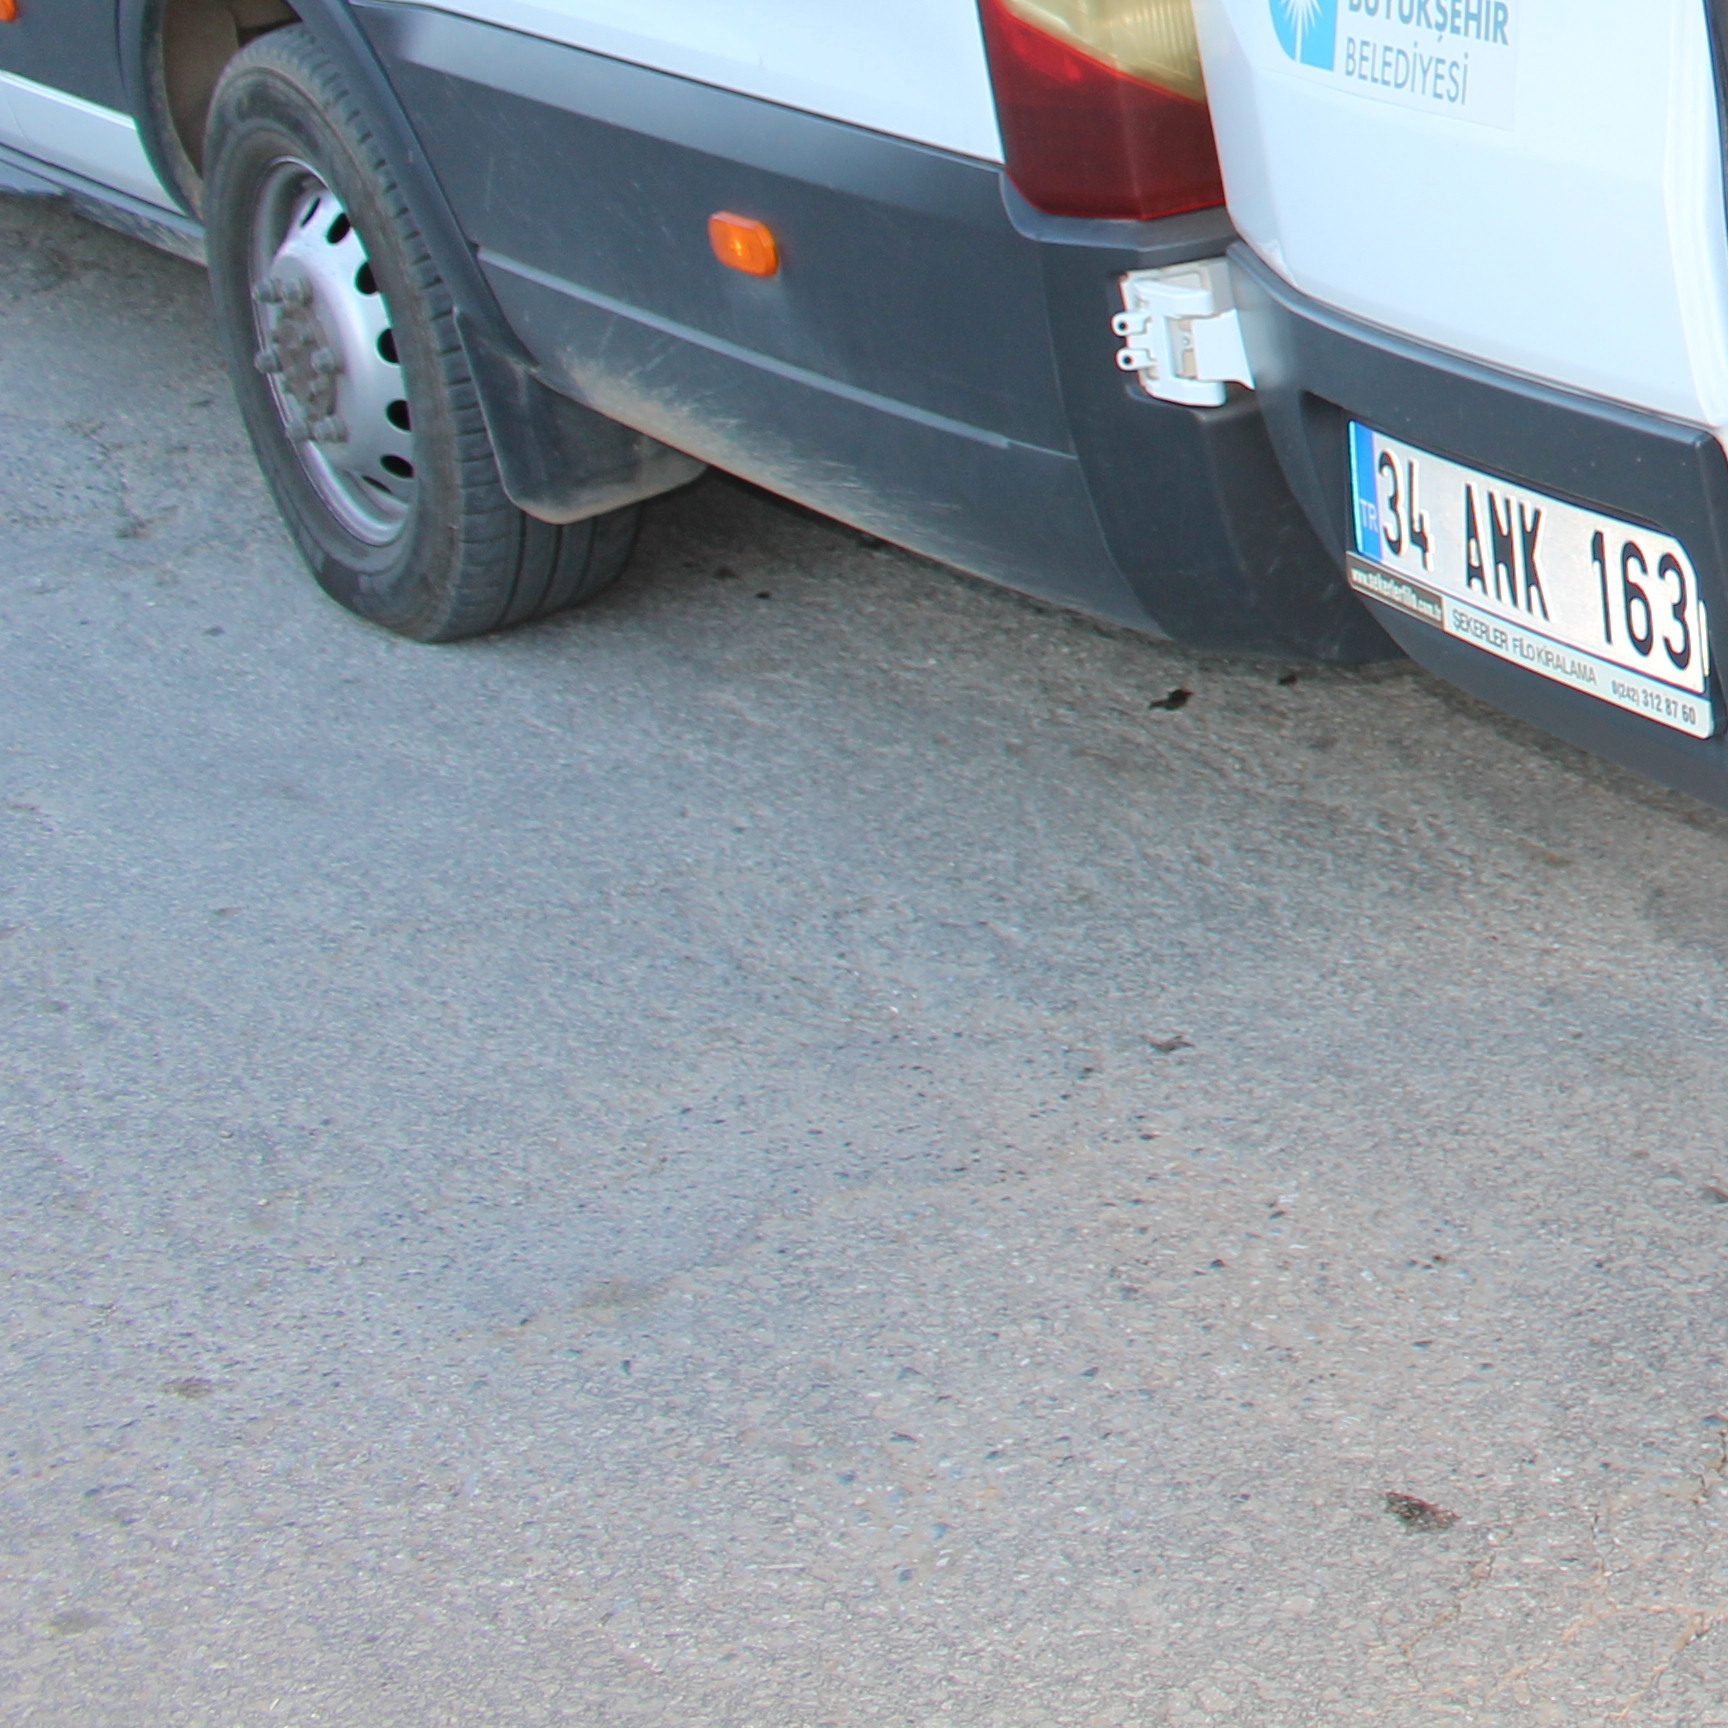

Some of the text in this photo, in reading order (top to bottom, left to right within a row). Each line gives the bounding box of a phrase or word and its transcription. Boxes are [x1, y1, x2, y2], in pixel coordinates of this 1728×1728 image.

[1345, 36, 1469, 106] BELEDİYESİ
[1359, 498, 1379, 534] TR
[1377, 449, 1691, 670] 34 ANK 163
[1452, 608, 1509, 652] ŞEKERLER
[1641, 688, 1662, 713] 312
[1681, 702, 1697, 726] 60
